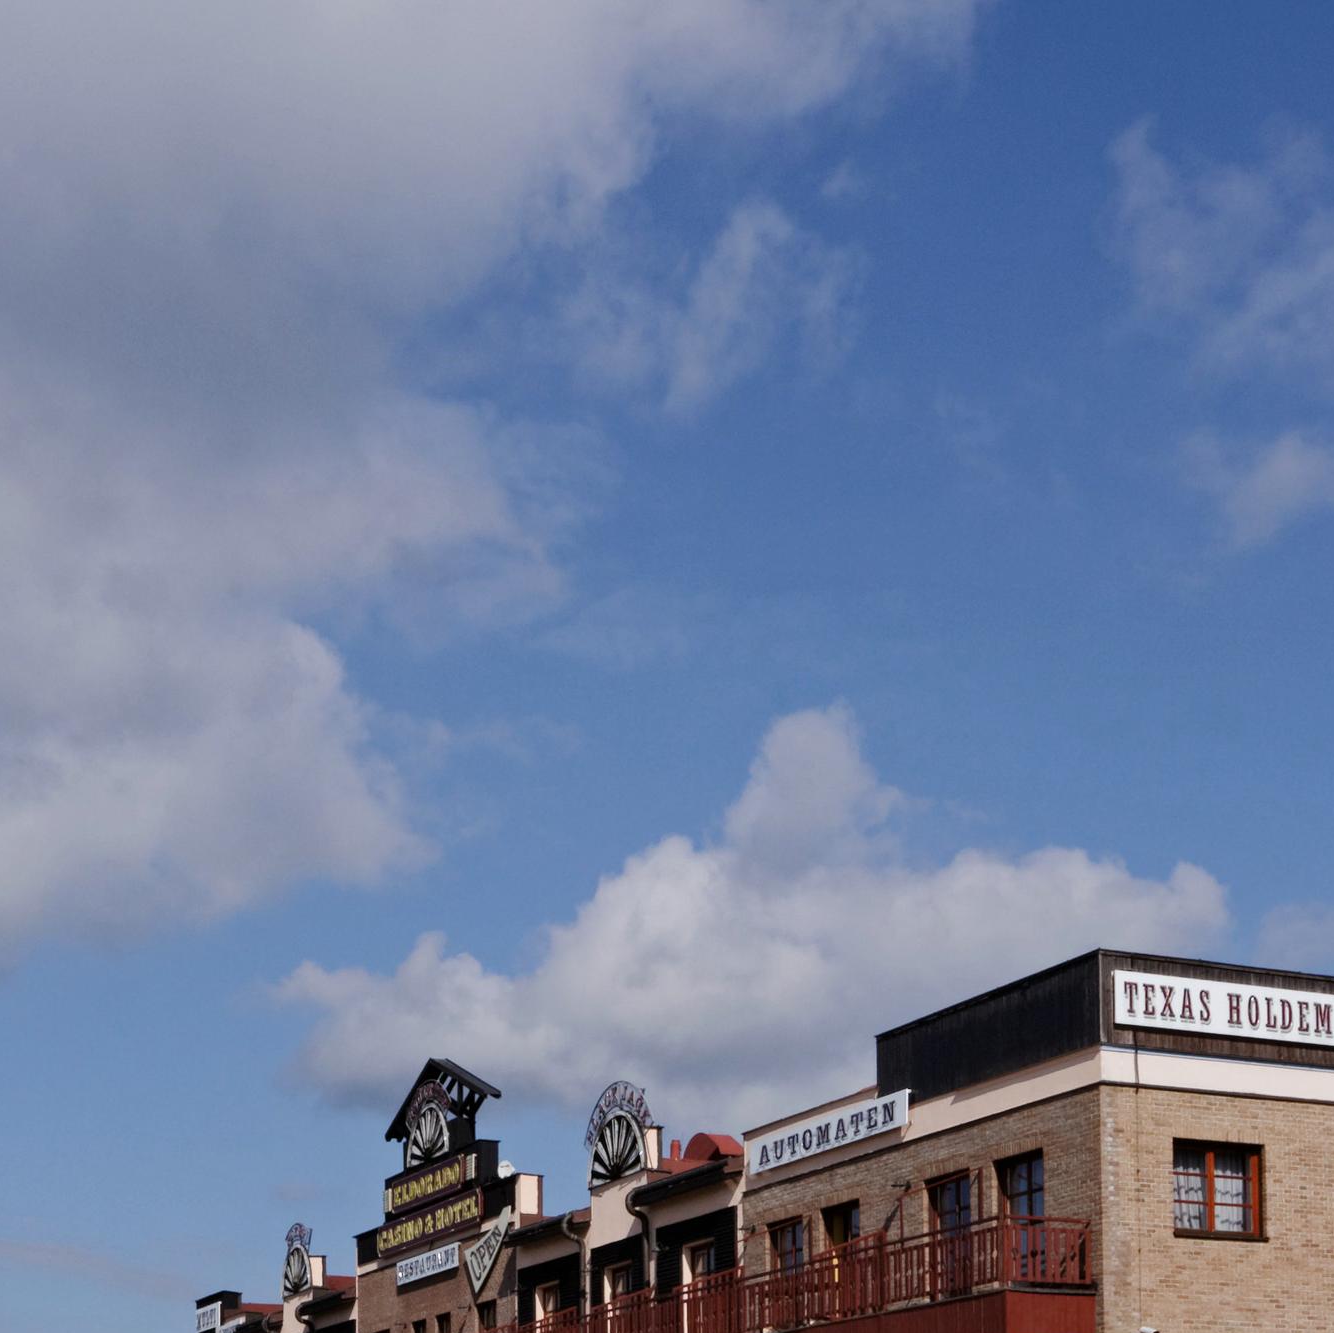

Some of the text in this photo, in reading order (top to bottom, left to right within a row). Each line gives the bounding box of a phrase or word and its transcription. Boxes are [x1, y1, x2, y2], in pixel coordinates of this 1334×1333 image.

[1123, 981, 1211, 1022] TEXAS
[1227, 993, 1333, 1034] HOLDEM
[758, 1100, 897, 1166] AUTOMATEN
[393, 1162, 460, 1207] ELDORADO
[378, 1195, 478, 1251] CASINO & HOTEL
[398, 1247, 456, 1281] RESTAURANT
[470, 1226, 502, 1281] OPEN
